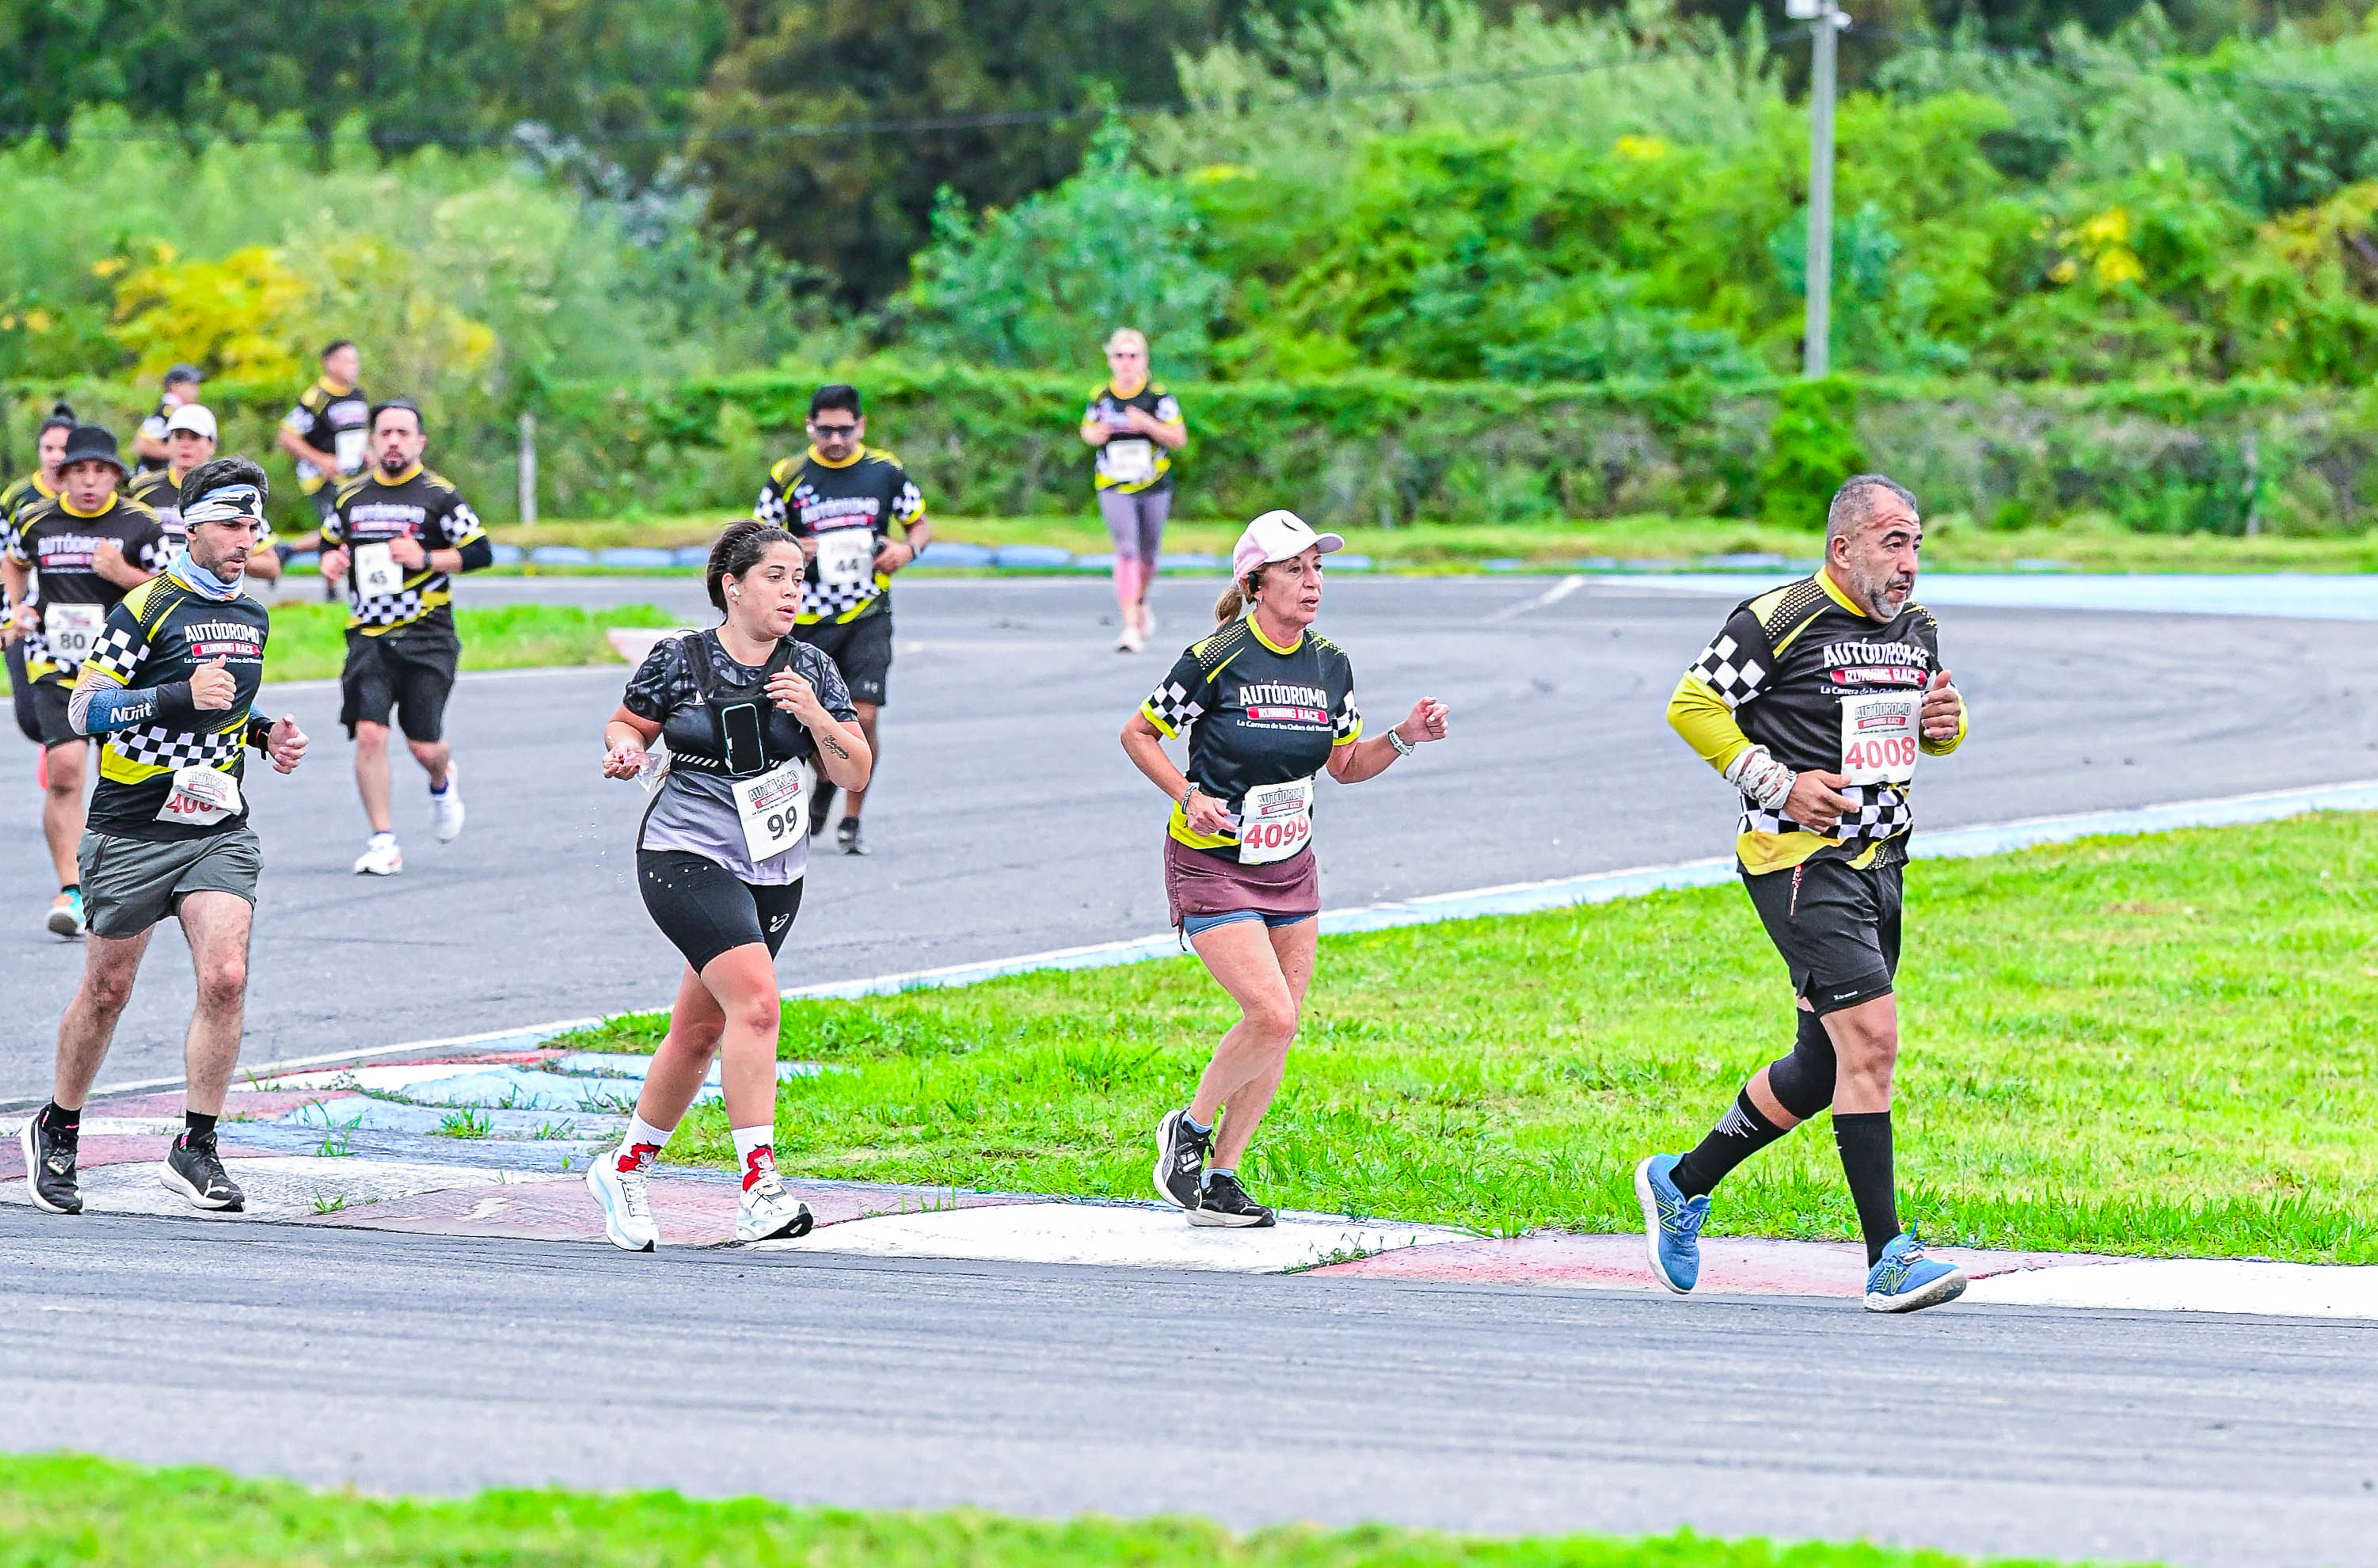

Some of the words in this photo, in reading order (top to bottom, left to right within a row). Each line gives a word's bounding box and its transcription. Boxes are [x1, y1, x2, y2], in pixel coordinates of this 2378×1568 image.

[184, 618, 260, 645] AUTÓDROMO
[60, 634, 85, 650] 80
[1844, 668, 1889, 683] RUNNING
[1892, 668, 1920, 685] RACE
[1239, 679, 1328, 709] AUTÓDROMO
[1832, 686, 1858, 695] Carrera
[1298, 709, 1321, 722] RACE
[1855, 700, 1911, 720] AUTÓDROMO
[1246, 721, 1270, 729] Carrera
[1844, 736, 1916, 770] 4008
[767, 805, 797, 841] 99
[1244, 814, 1308, 848] 4099
